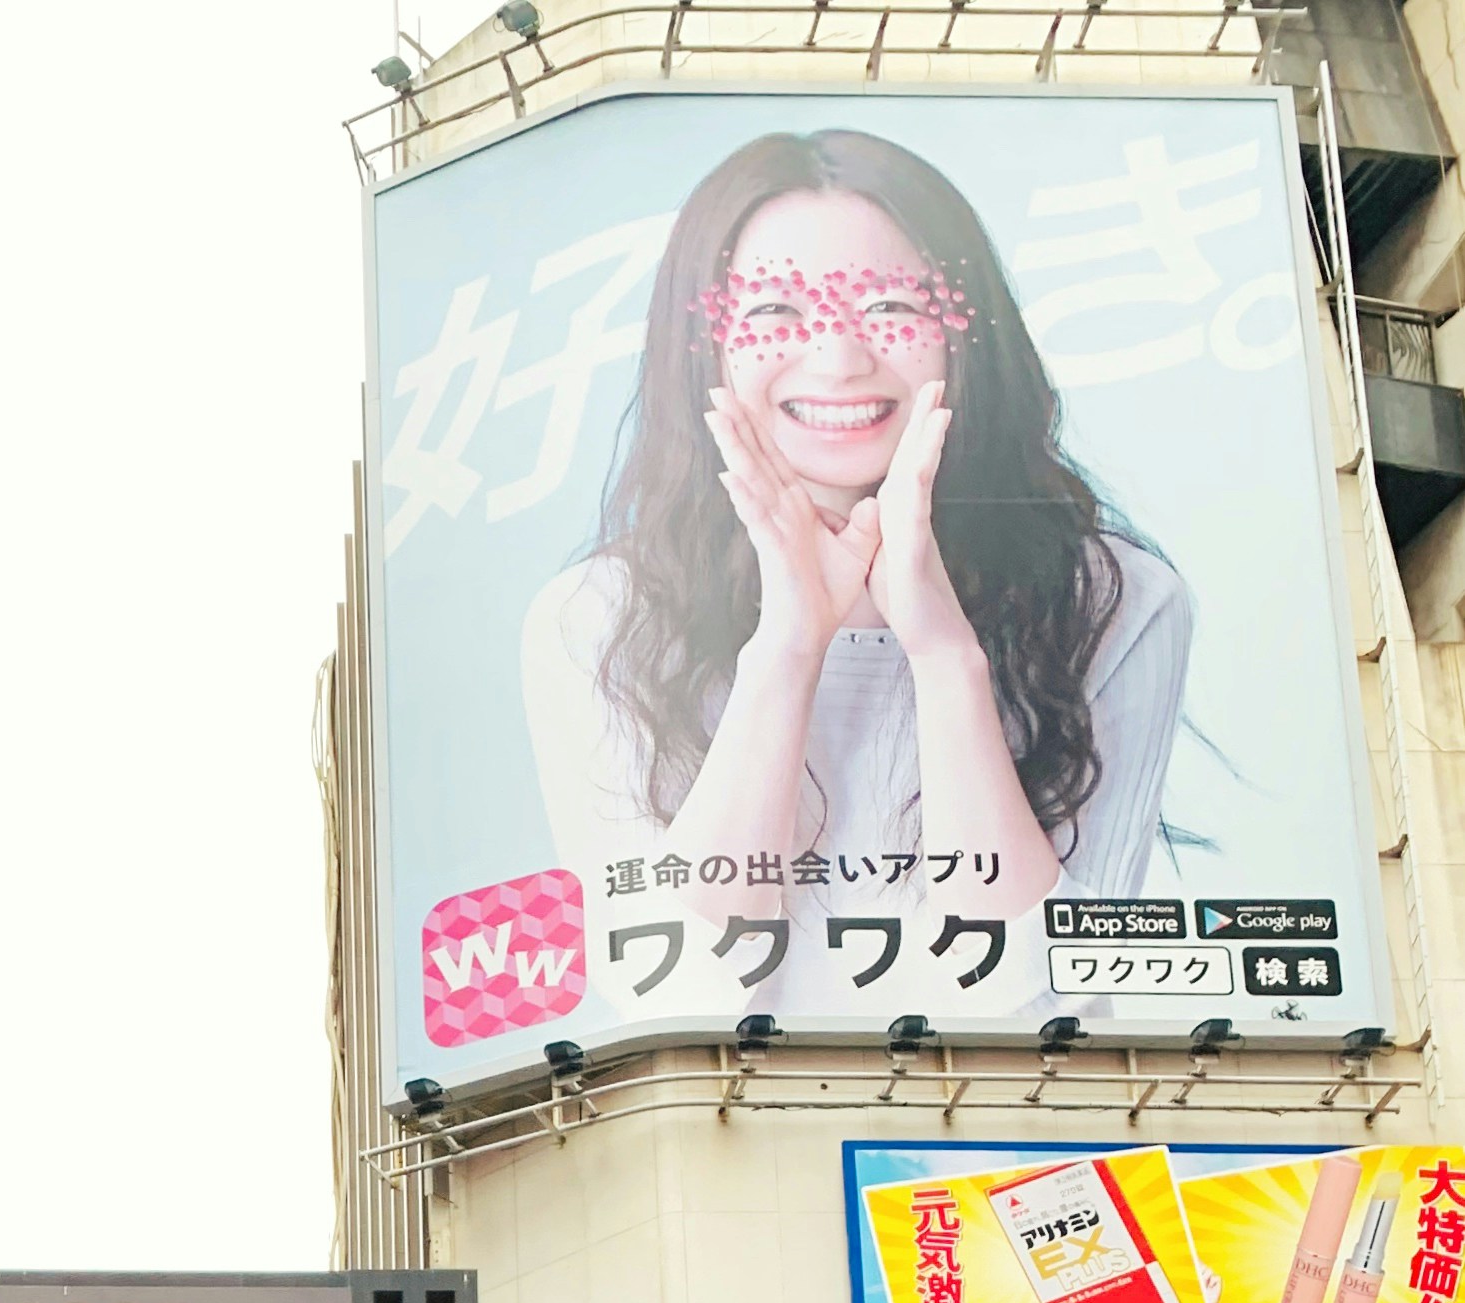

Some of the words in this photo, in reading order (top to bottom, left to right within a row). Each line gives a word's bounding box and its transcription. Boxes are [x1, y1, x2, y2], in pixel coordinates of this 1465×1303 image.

[604, 850, 1003, 899] 運命の出会いアプリ
[1079, 914, 1123, 937] App
[1125, 914, 1179, 933] Store
[1237, 913, 1296, 932] Google
[1299, 914, 1333, 932] play
[607, 913, 1011, 997] ワクワク
[1070, 956, 1210, 984] ワクワク
[1255, 956, 1329, 987] 検索
[1019, 1208, 1100, 1250] アリナミン
[1029, 1225, 1113, 1281] EX
[1055, 1247, 1131, 1292] PLUS
[1293, 1257, 1331, 1281] DHC
[1342, 1273, 1378, 1294] DHC
